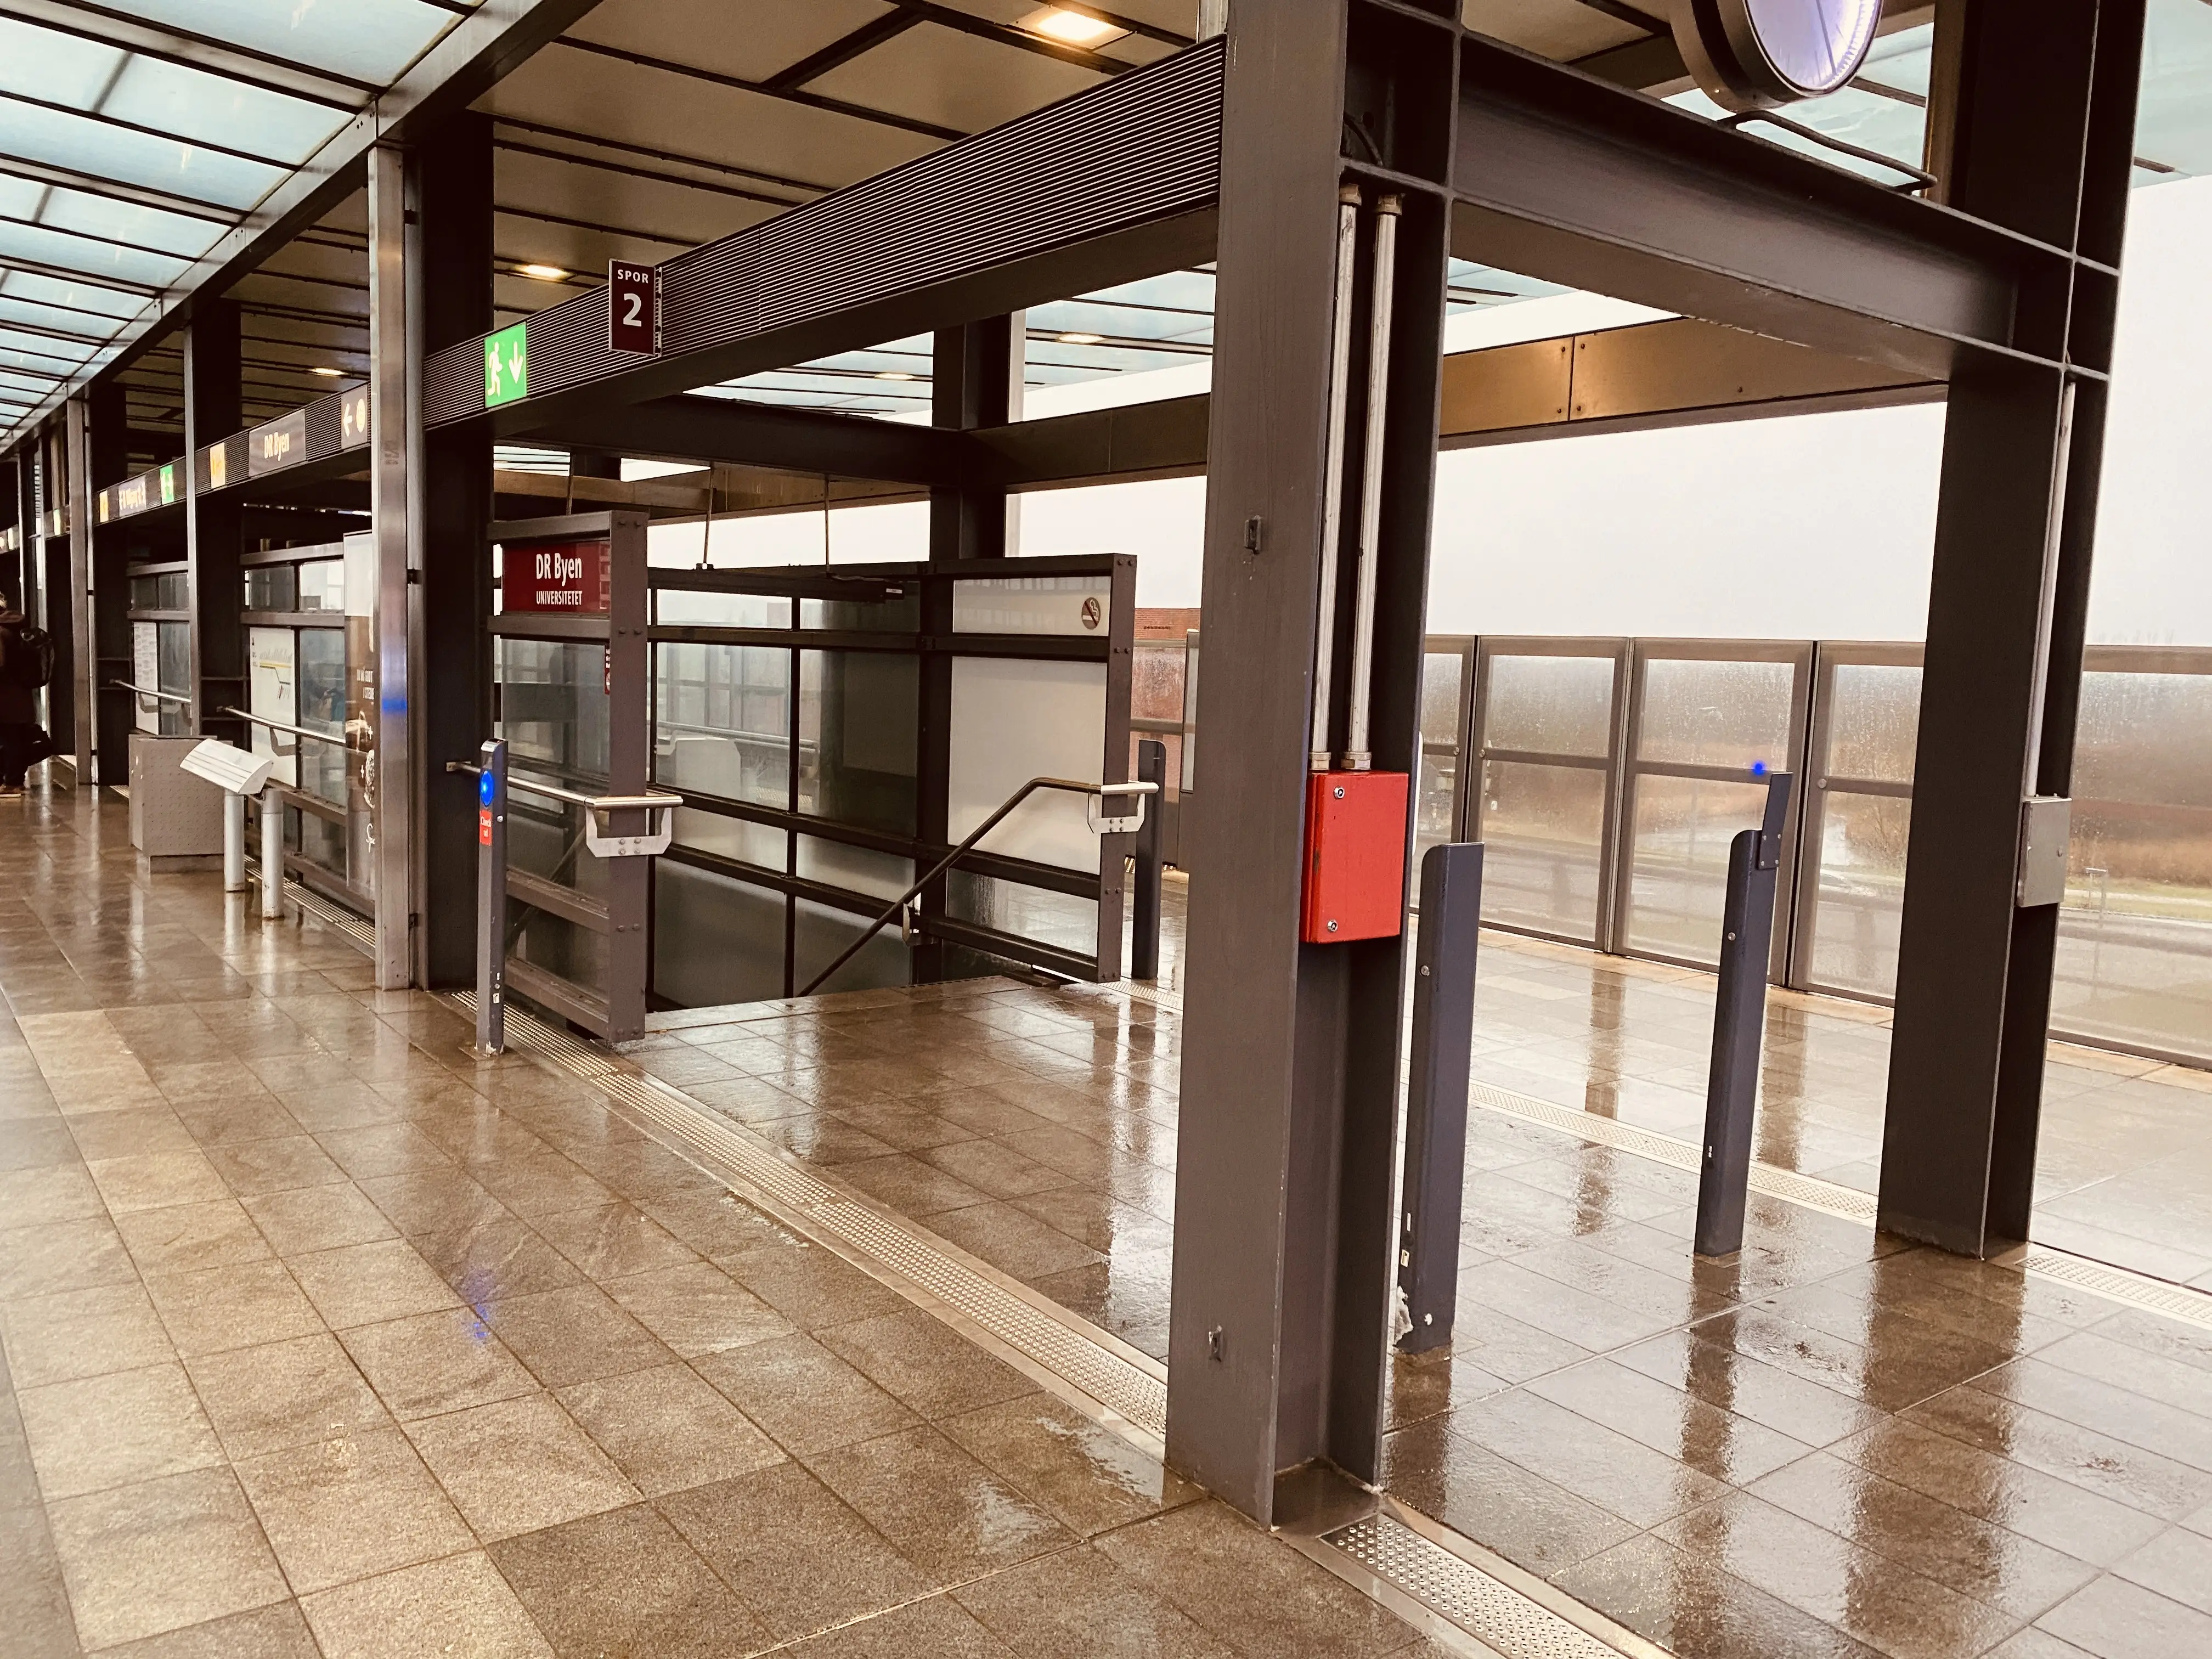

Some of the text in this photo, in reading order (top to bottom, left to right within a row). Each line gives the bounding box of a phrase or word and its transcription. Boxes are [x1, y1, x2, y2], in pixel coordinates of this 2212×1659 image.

[617, 269, 648, 284] SPOR
[623, 293, 642, 327] 2
[264, 431, 290, 461] DR Byen
[536, 552, 582, 586] DR Byen
[536, 590, 583, 605] UNIVERSITETET
